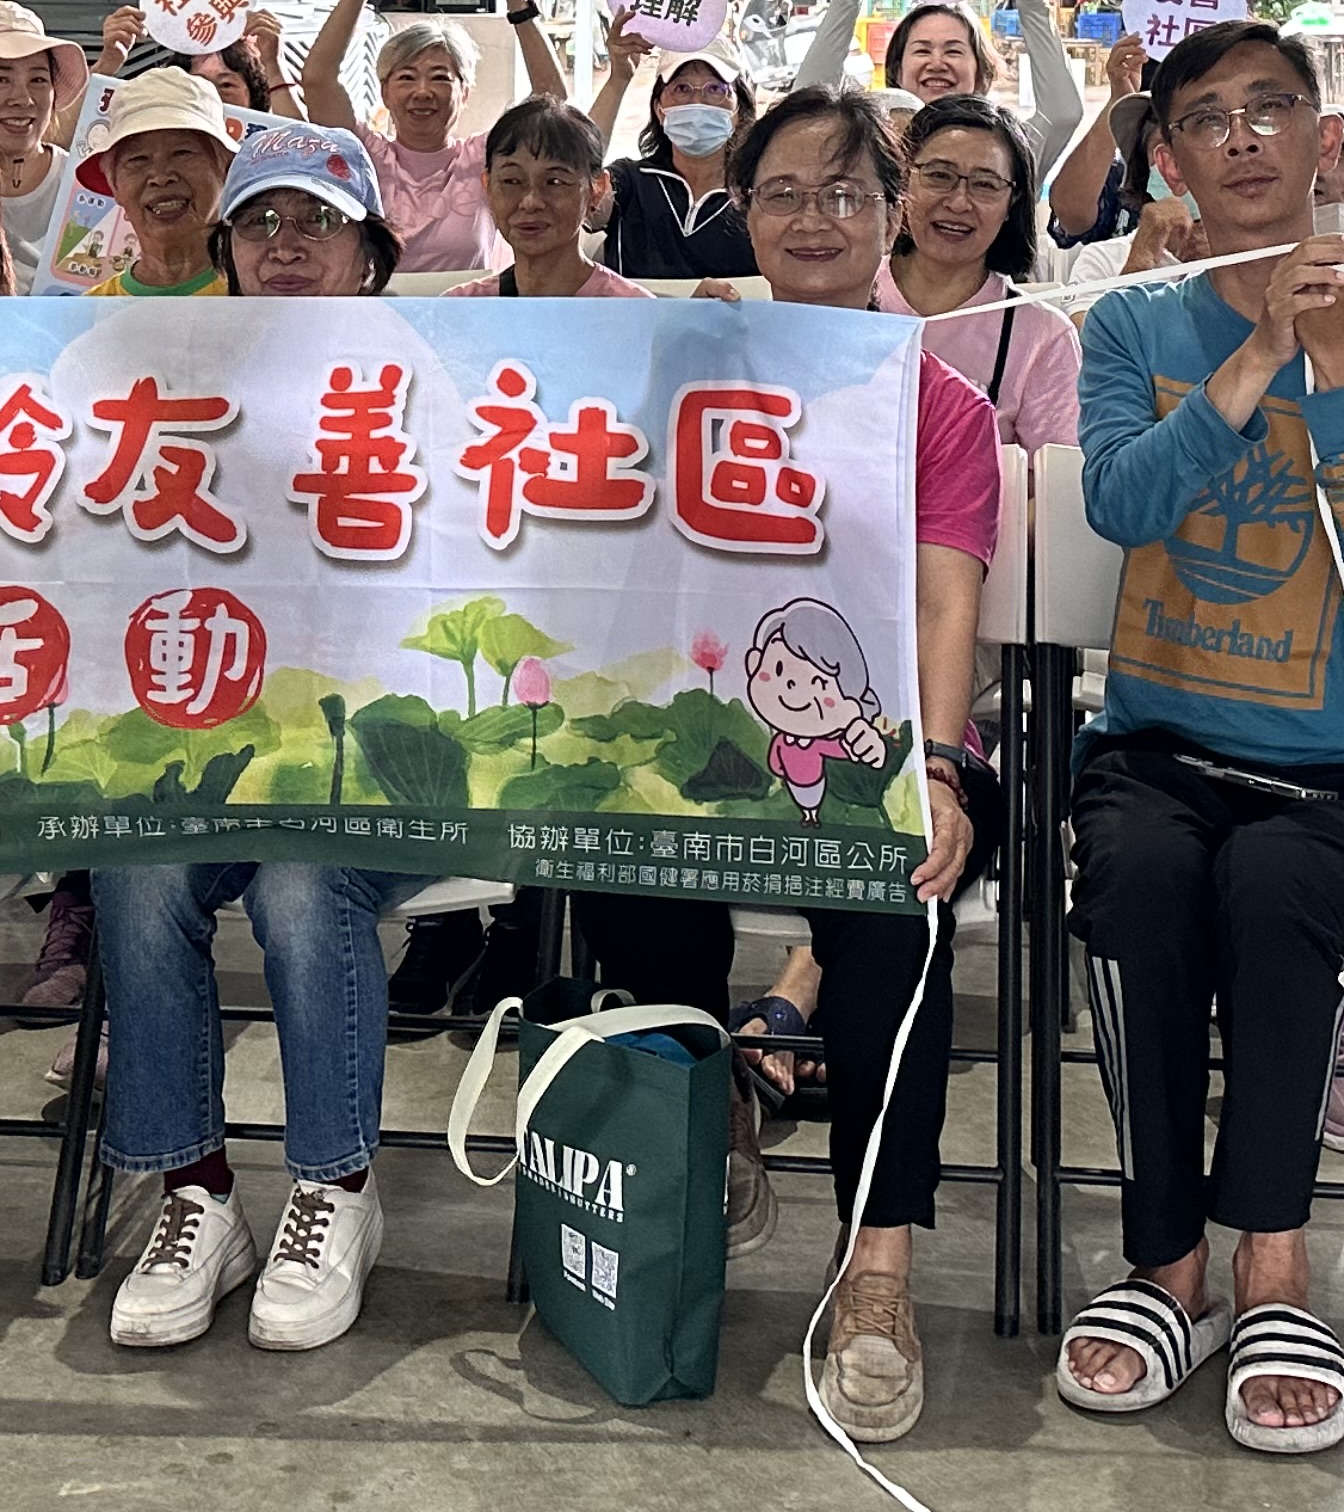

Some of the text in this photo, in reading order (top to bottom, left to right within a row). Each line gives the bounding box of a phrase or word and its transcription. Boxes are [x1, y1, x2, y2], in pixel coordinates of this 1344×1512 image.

[1142, 597, 1294, 664] Timberland
[507, 823, 908, 875] 協辦單位：臺南市白河區公所
